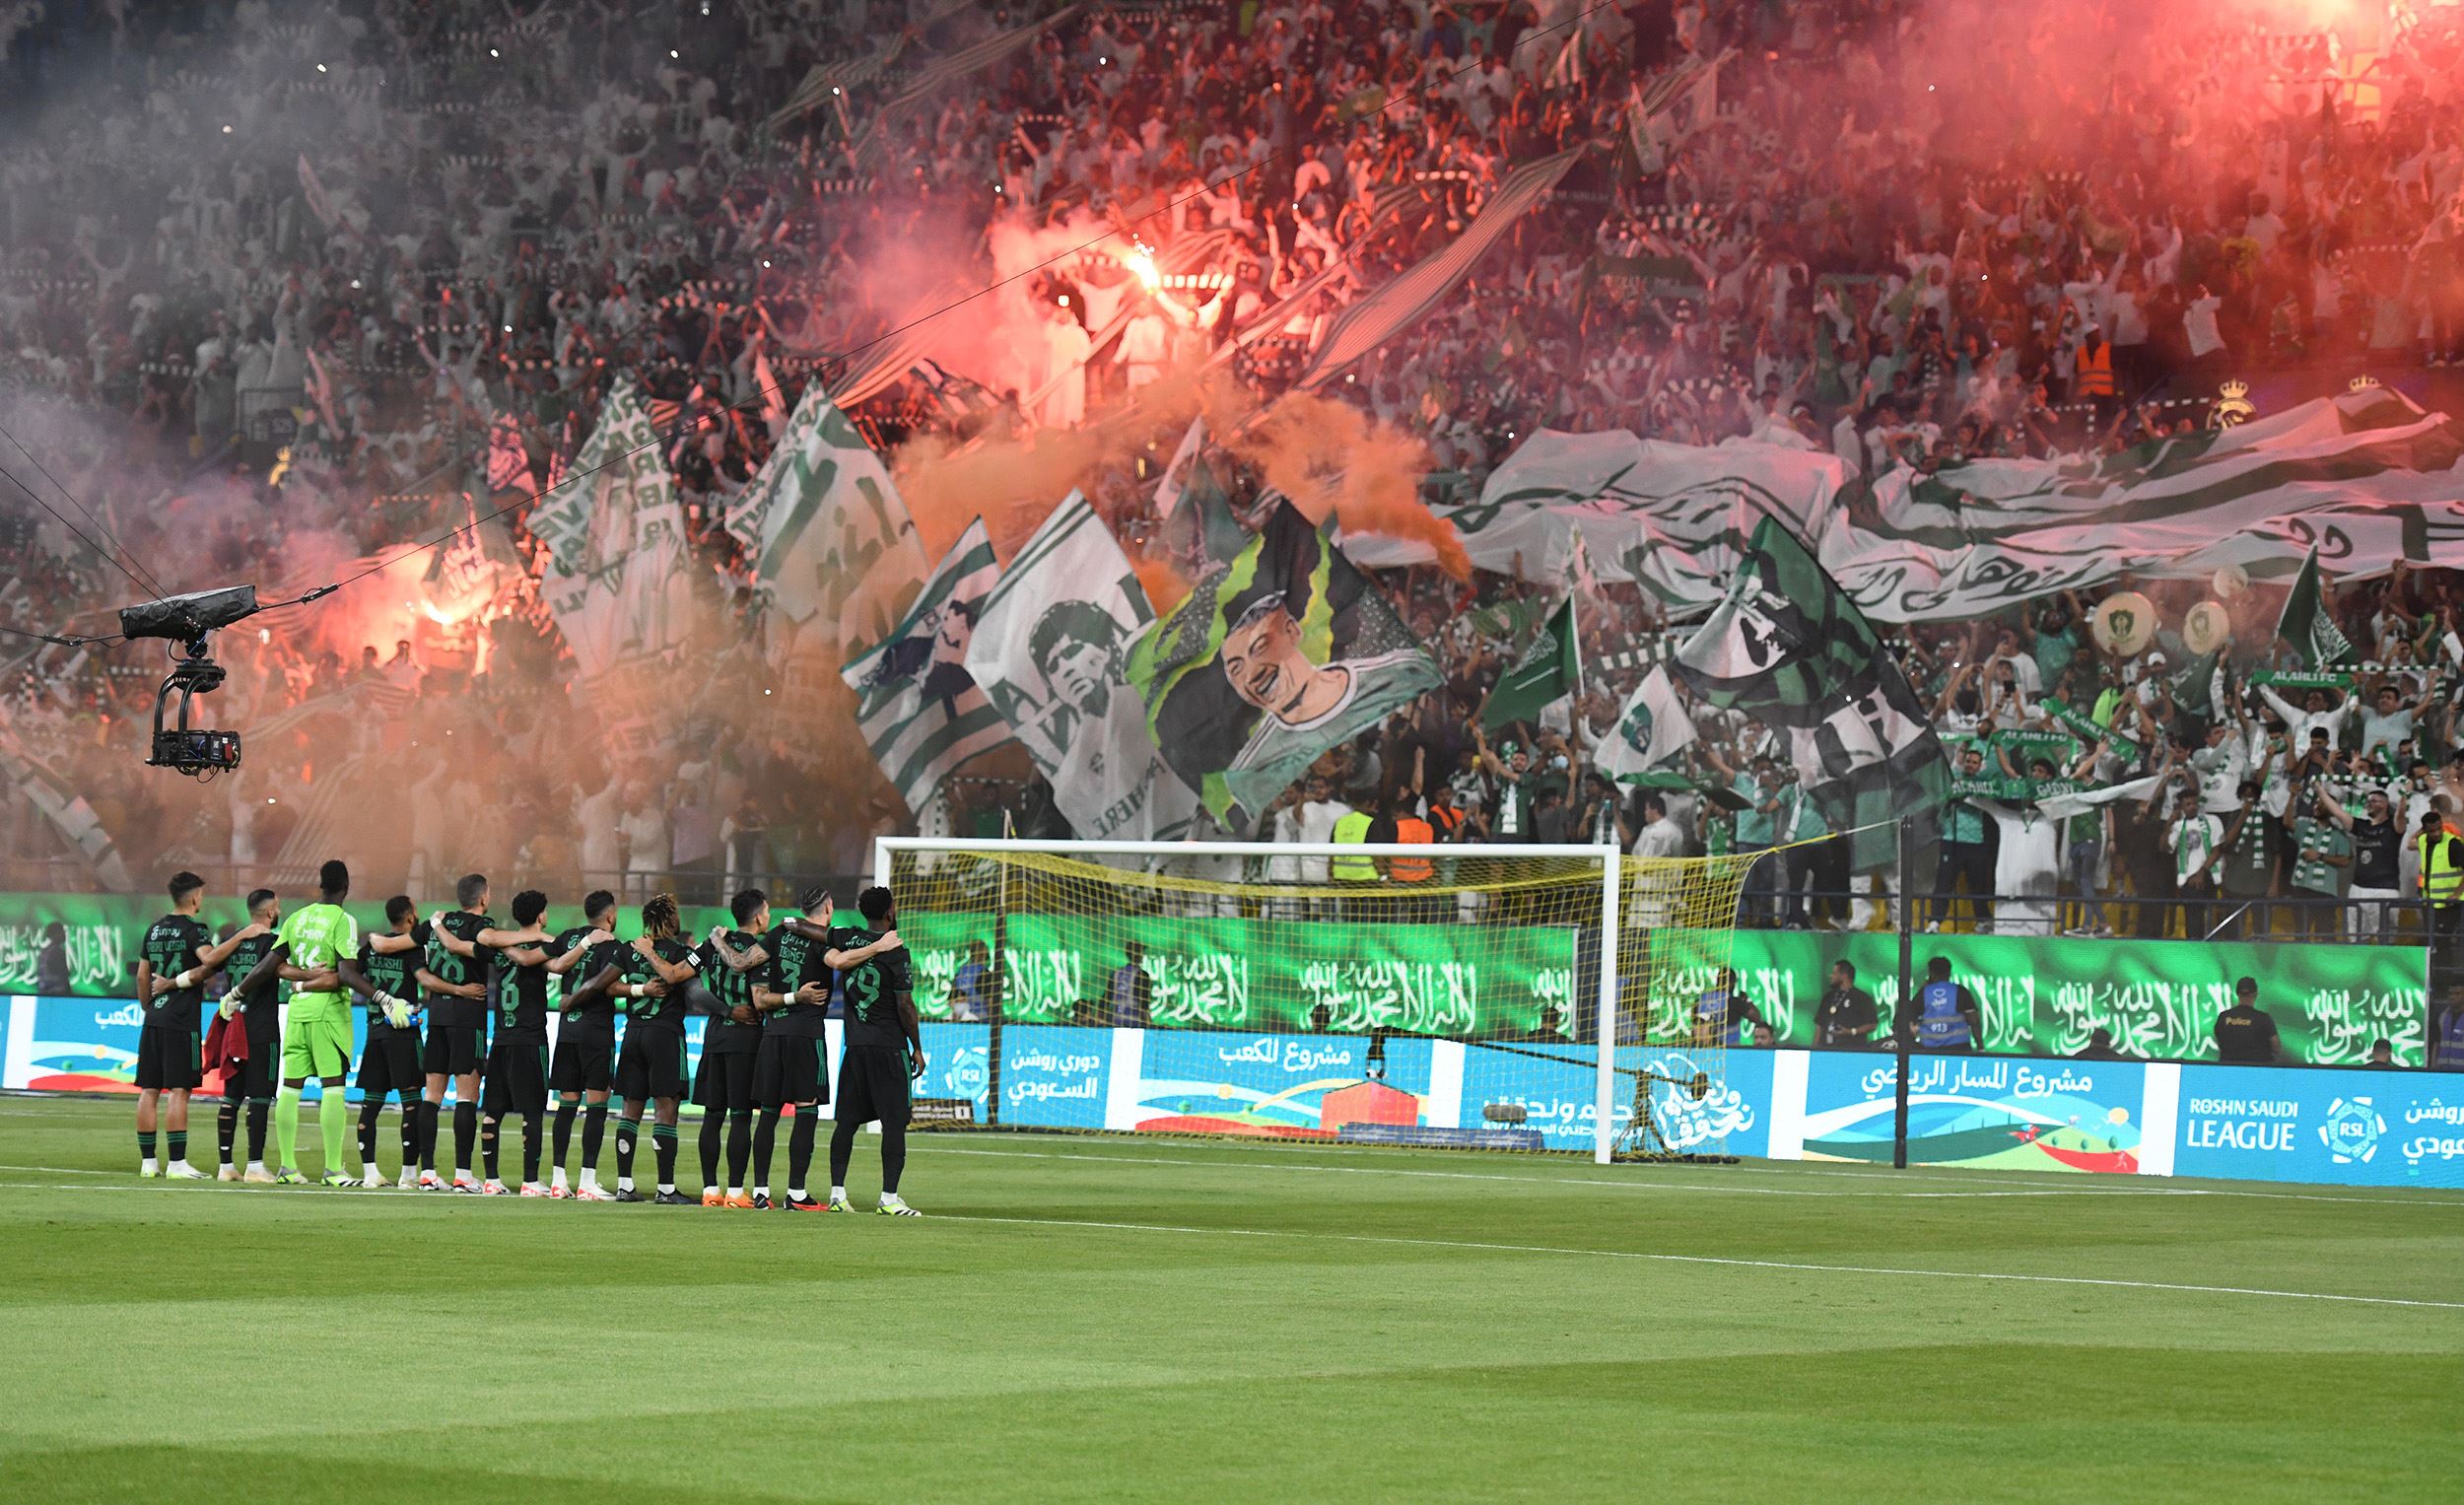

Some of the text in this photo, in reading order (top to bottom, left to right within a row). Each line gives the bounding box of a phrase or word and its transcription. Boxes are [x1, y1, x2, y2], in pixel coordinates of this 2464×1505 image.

[2225, 1016, 2252, 1026] Police
[1010, 1048, 1100, 1077] دوري روشن
[1283, 1042, 1351, 1072] مشروع
[1007, 1076, 1098, 1106] السعودي
[2012, 1067, 2093, 1098] مشروع
[2189, 1097, 2299, 1119] ROSHN SAUDI
[2186, 1119, 2296, 1151] LEAGUE
[2339, 1122, 2366, 1137] RSL
